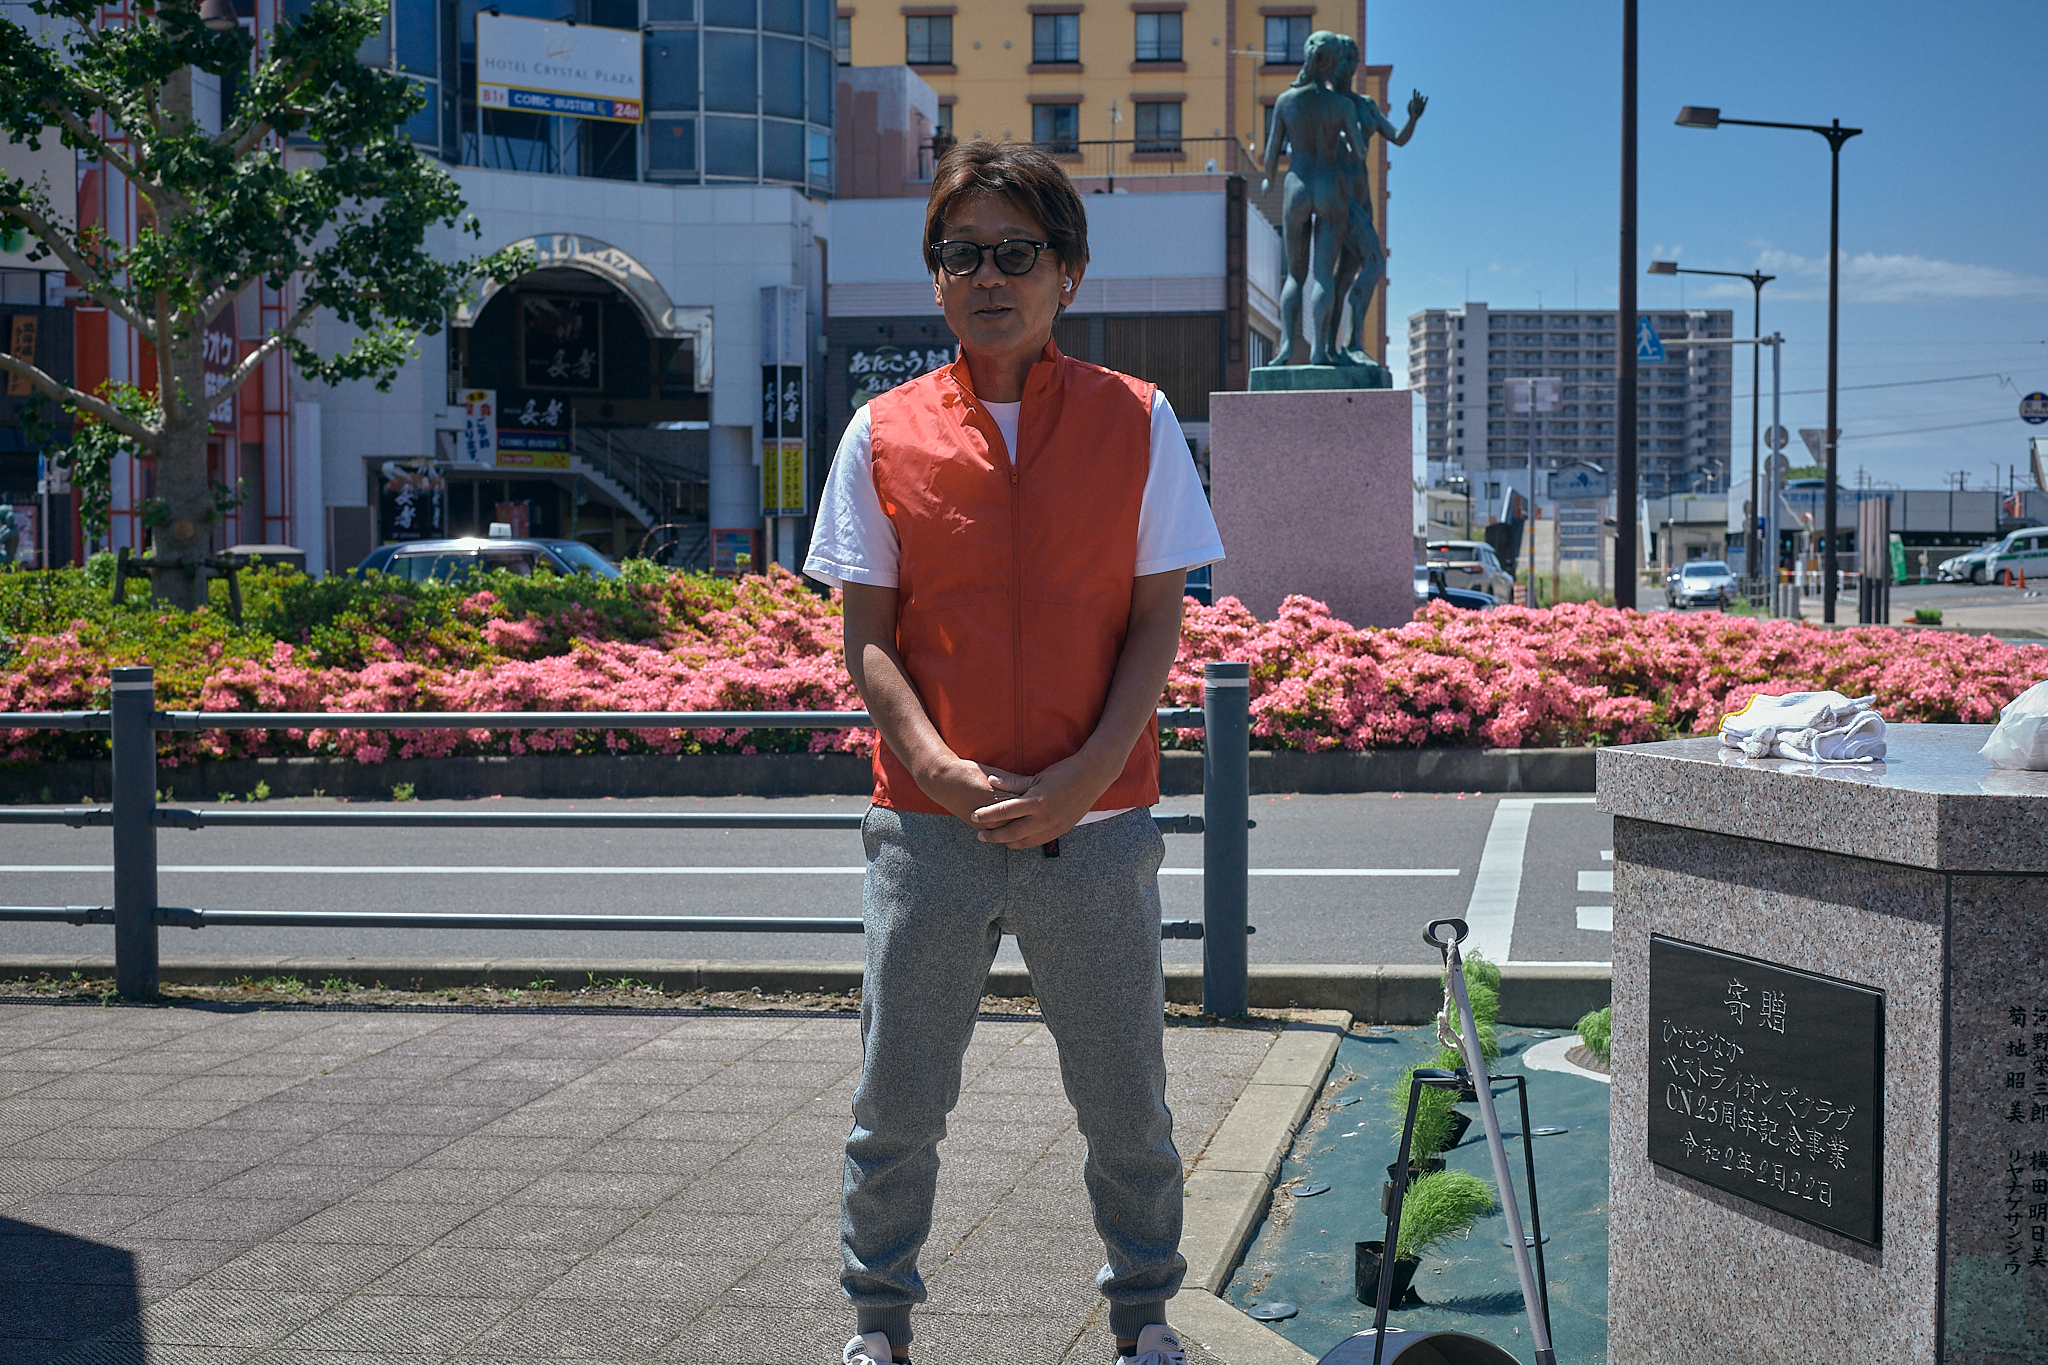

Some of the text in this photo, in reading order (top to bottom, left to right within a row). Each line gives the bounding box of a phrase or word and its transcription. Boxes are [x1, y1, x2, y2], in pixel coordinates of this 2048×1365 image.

[485, 57, 634, 84] HOTEL CRYSTAL PLAZA
[615, 103, 640, 118] 24H
[1723, 977, 1787, 1035] 寄贈
[1660, 1053, 1856, 1131] ベストライオンズクラブ
[2005, 1005, 2028, 1124] 菊地昭美
[1679, 1128, 1833, 1209] 令和2年2月22日
